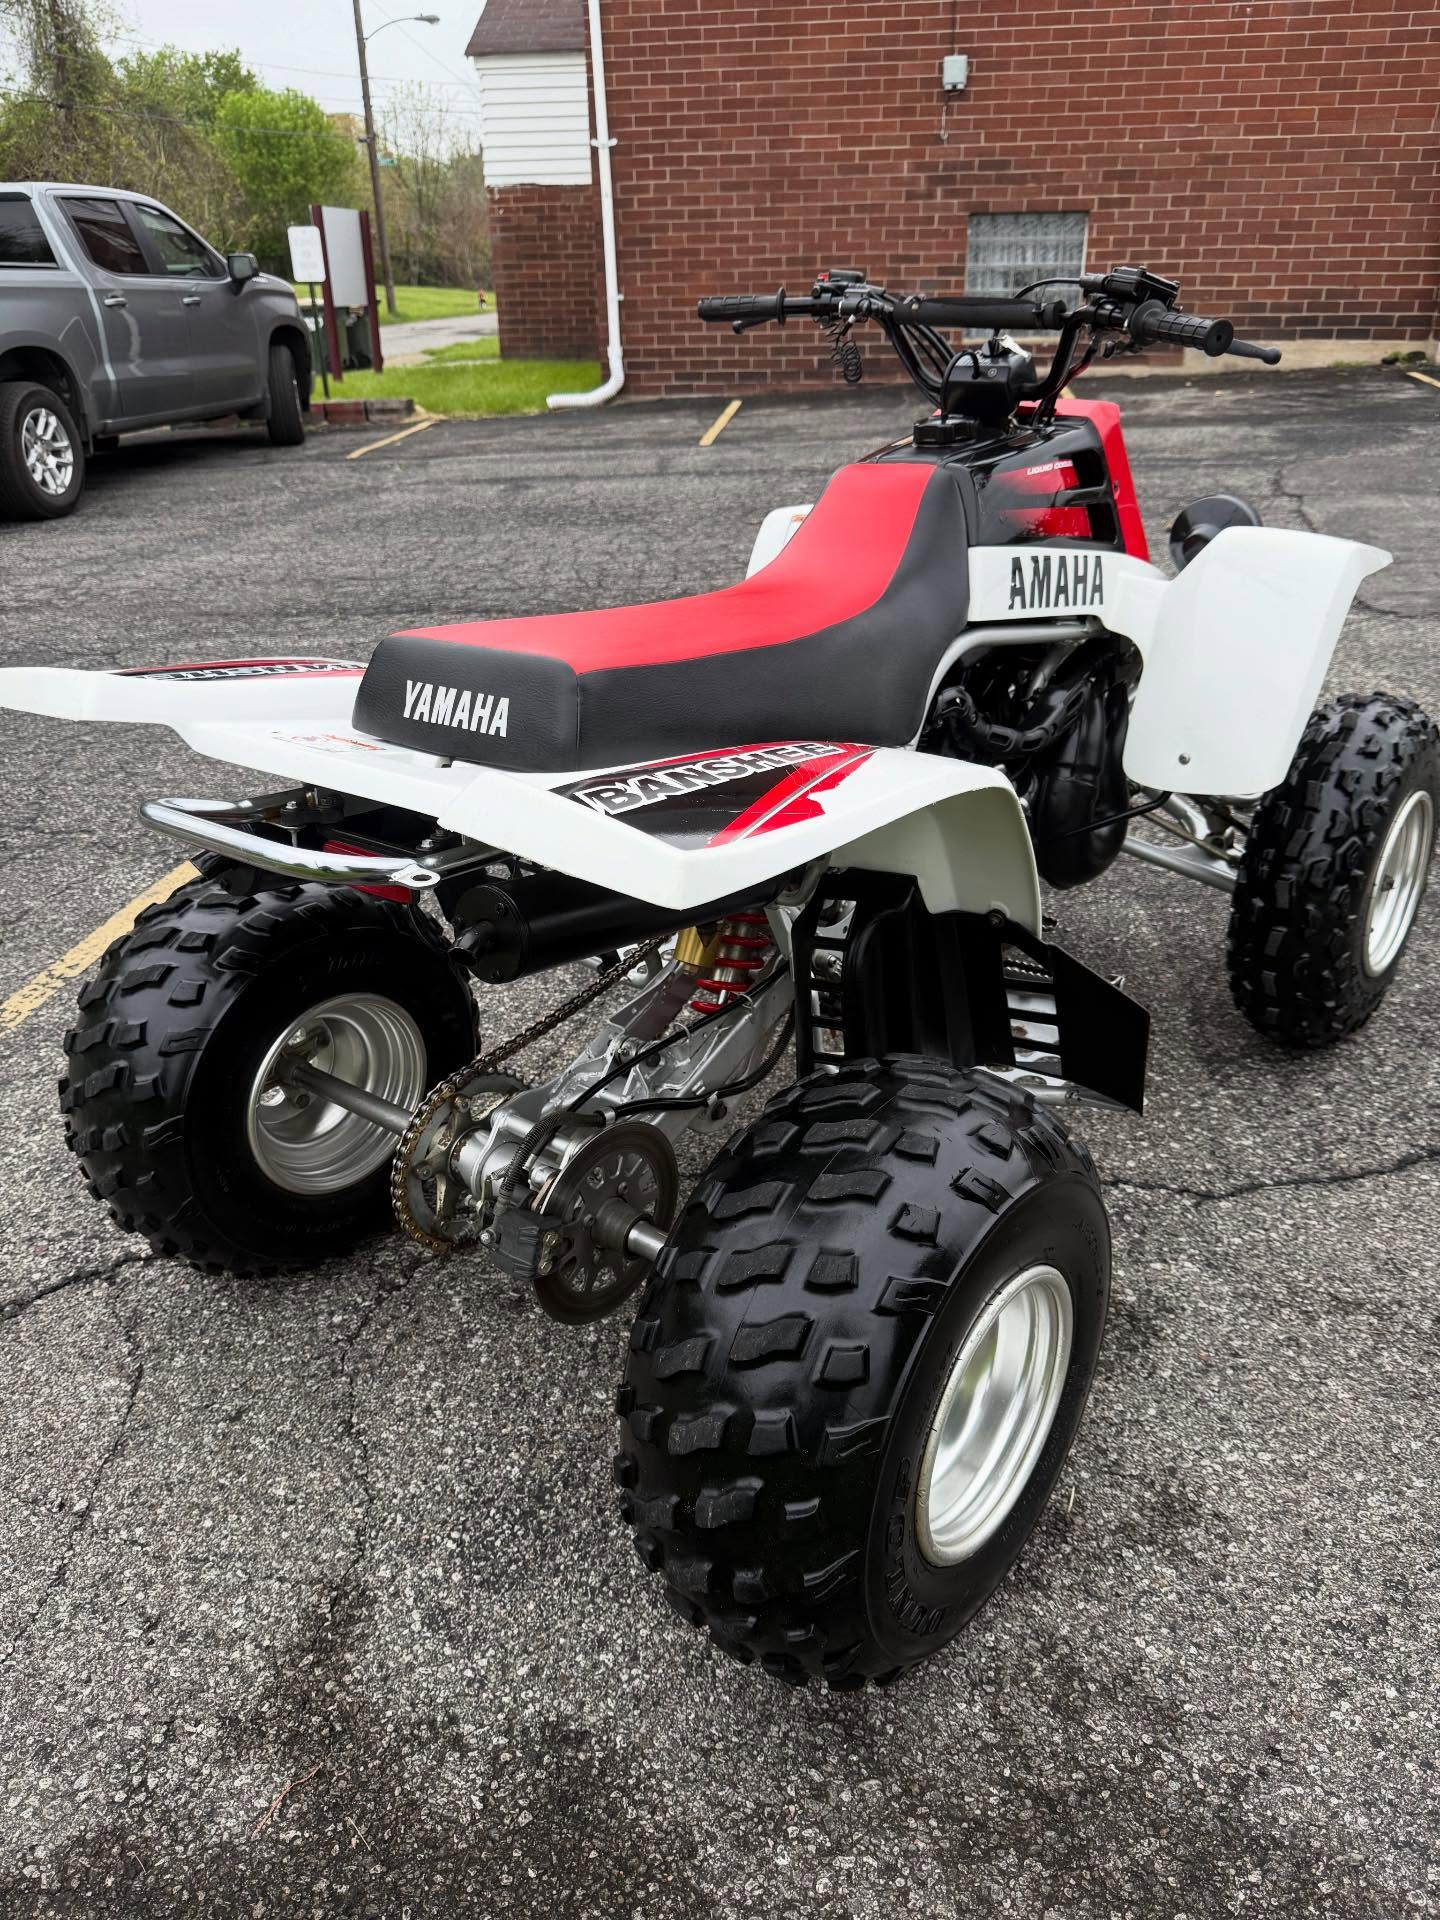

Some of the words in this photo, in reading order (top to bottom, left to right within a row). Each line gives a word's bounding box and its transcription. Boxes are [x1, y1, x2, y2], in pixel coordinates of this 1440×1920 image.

[1008, 555, 1104, 610] AMAHA
[403, 680, 510, 738] YAMAHA
[575, 742, 848, 815] BANSHEE
